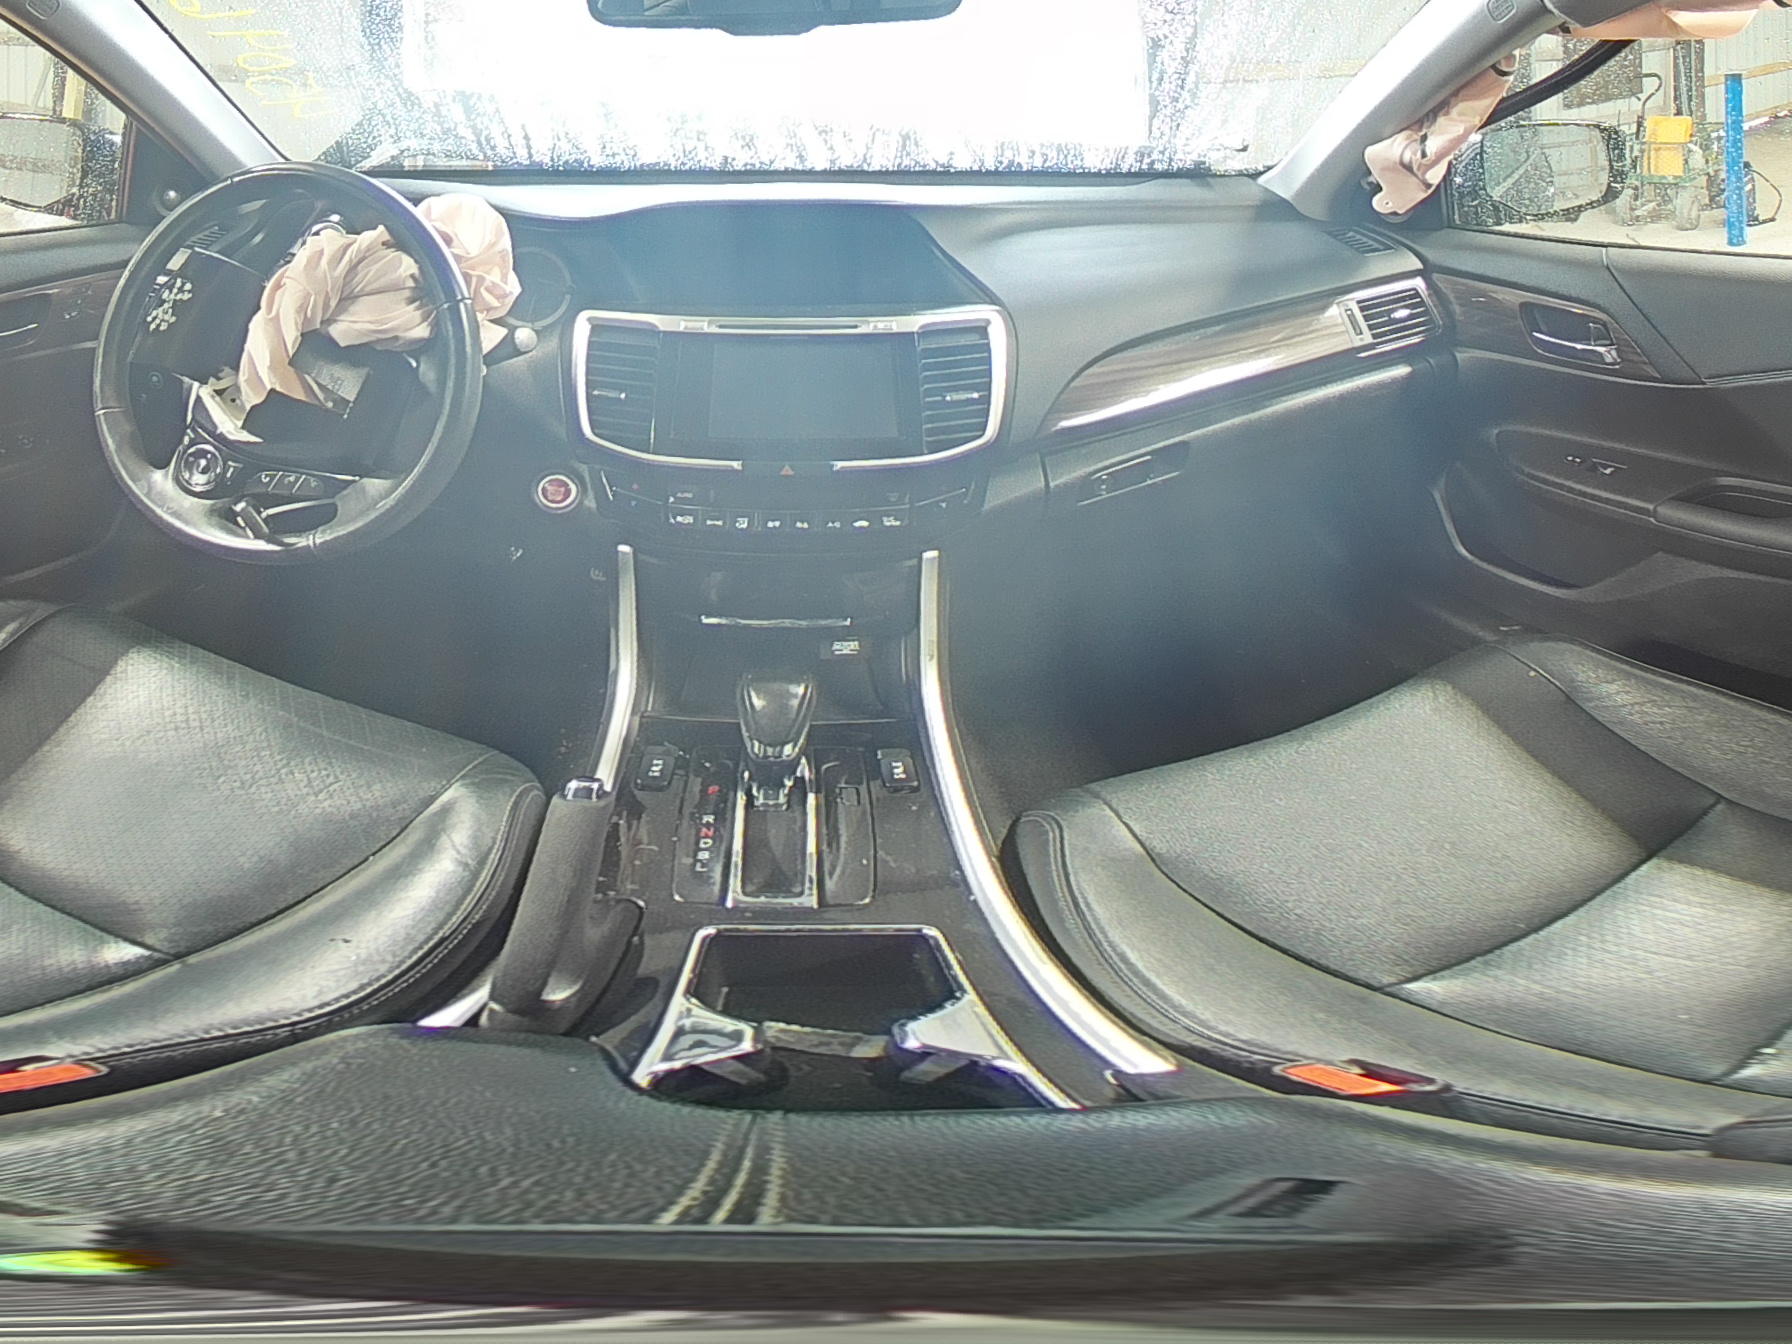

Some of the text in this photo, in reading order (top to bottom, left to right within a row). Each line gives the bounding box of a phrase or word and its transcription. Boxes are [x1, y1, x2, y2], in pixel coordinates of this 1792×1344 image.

[702, 815, 715, 824] R
[700, 827, 714, 837] N
[699, 838, 713, 848] D
[695, 863, 708, 872] L
